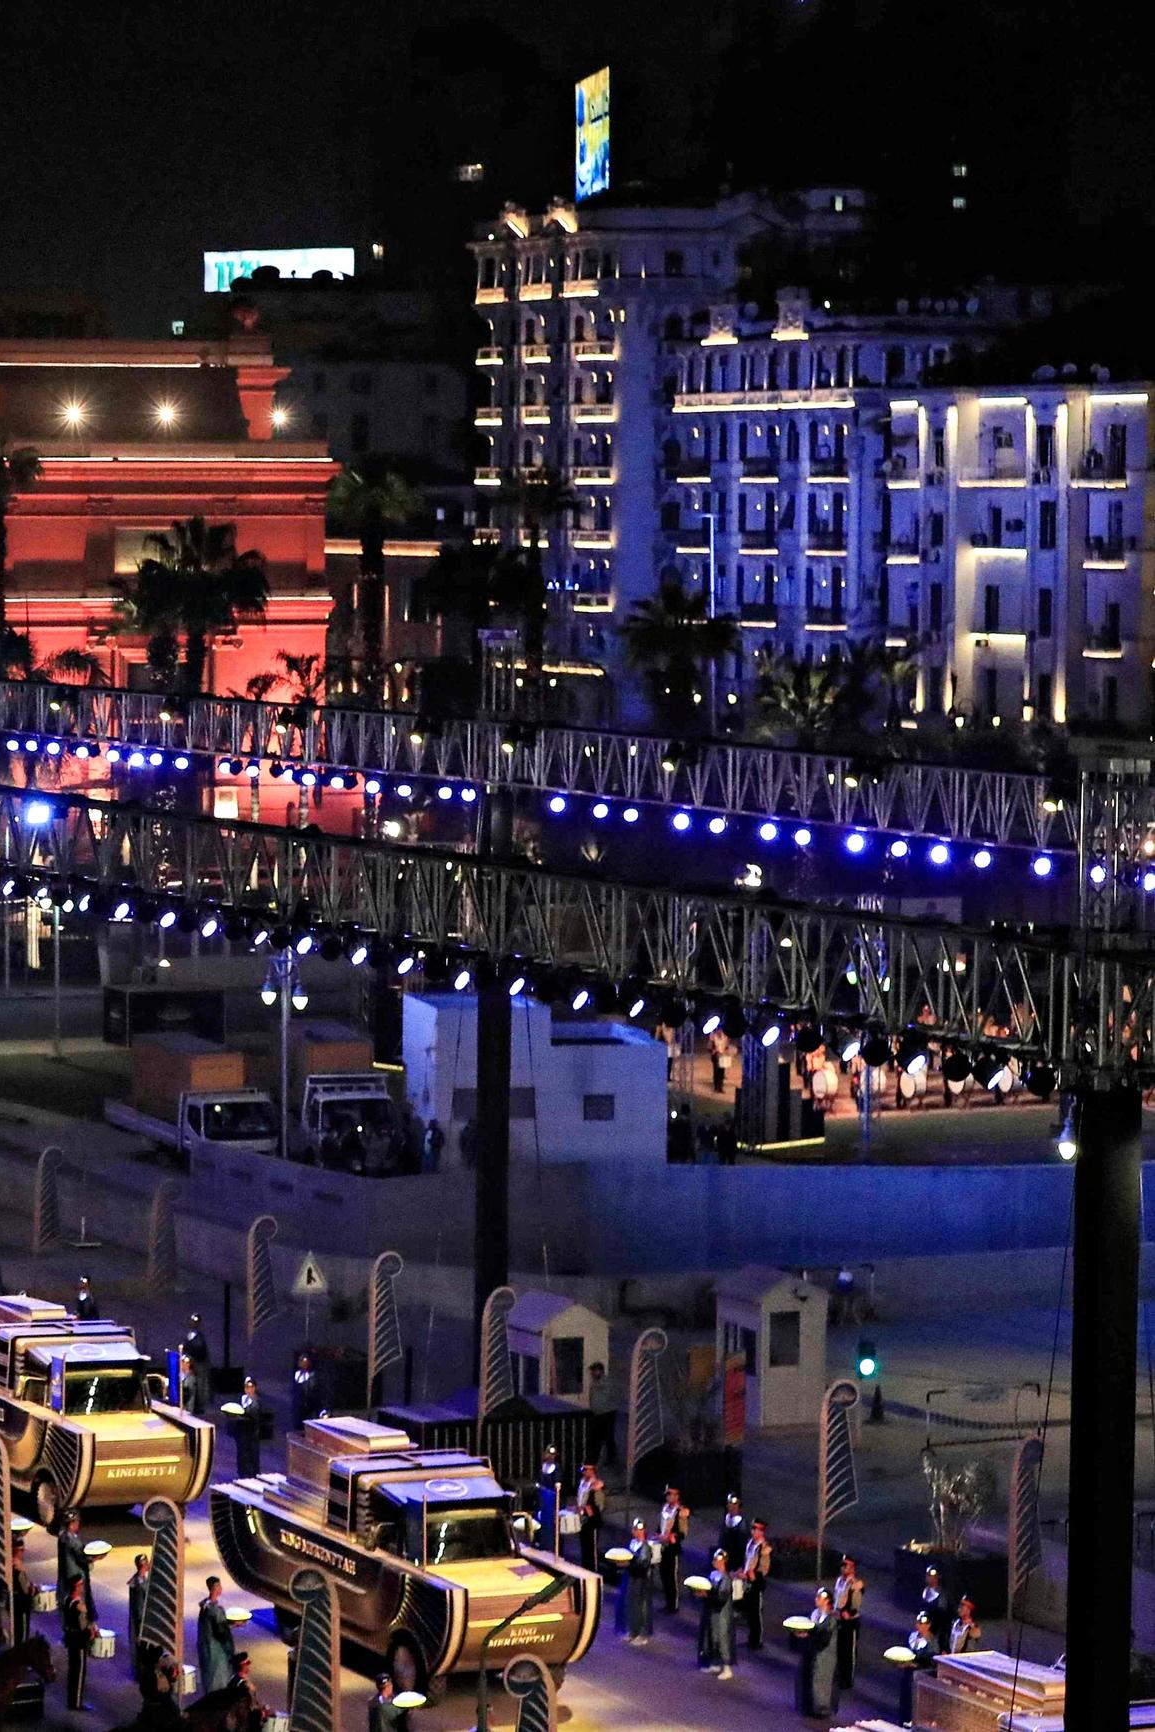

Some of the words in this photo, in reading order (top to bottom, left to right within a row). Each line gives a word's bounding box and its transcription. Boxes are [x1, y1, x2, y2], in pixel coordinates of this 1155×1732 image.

[107, 1468, 137, 1479] KING
[137, 1466, 167, 1478] SETY
[167, 1465, 177, 1476] II
[509, 1627, 538, 1638] KING
